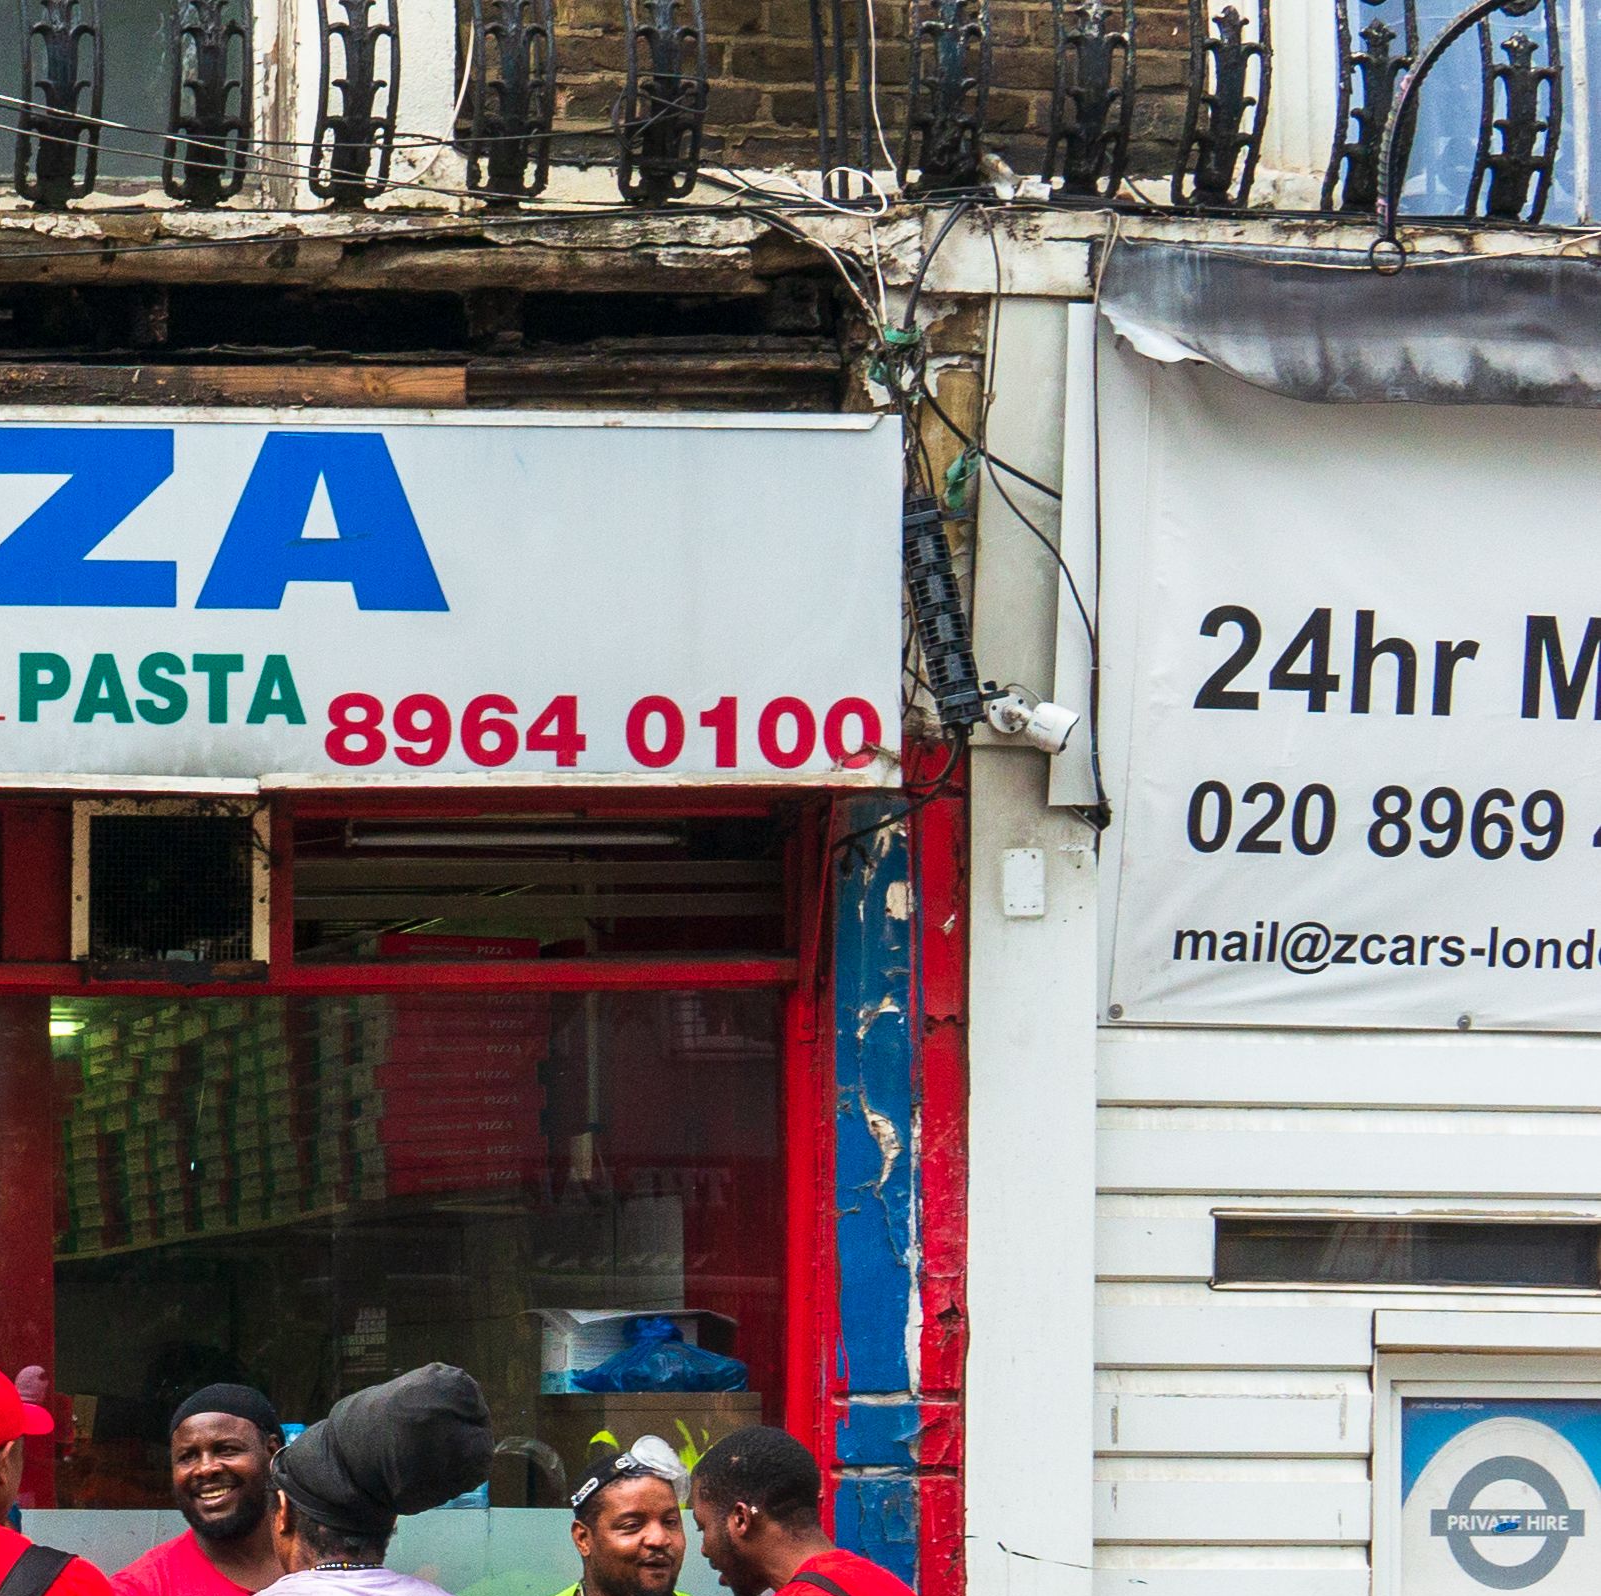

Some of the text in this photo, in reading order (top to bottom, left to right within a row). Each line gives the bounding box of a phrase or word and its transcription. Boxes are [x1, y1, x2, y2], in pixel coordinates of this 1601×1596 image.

[19, 652, 306, 725] PASTA
[1194, 606, 1479, 715] 24hr
[325, 692, 882, 769] 8964 0100
[1188, 781, 1335, 855] 020
[1368, 786, 1563, 861] 8969
[1172, 920, 1601, 975] mail@zcars-lond
[1527, 1514, 1569, 1531] HIRE
